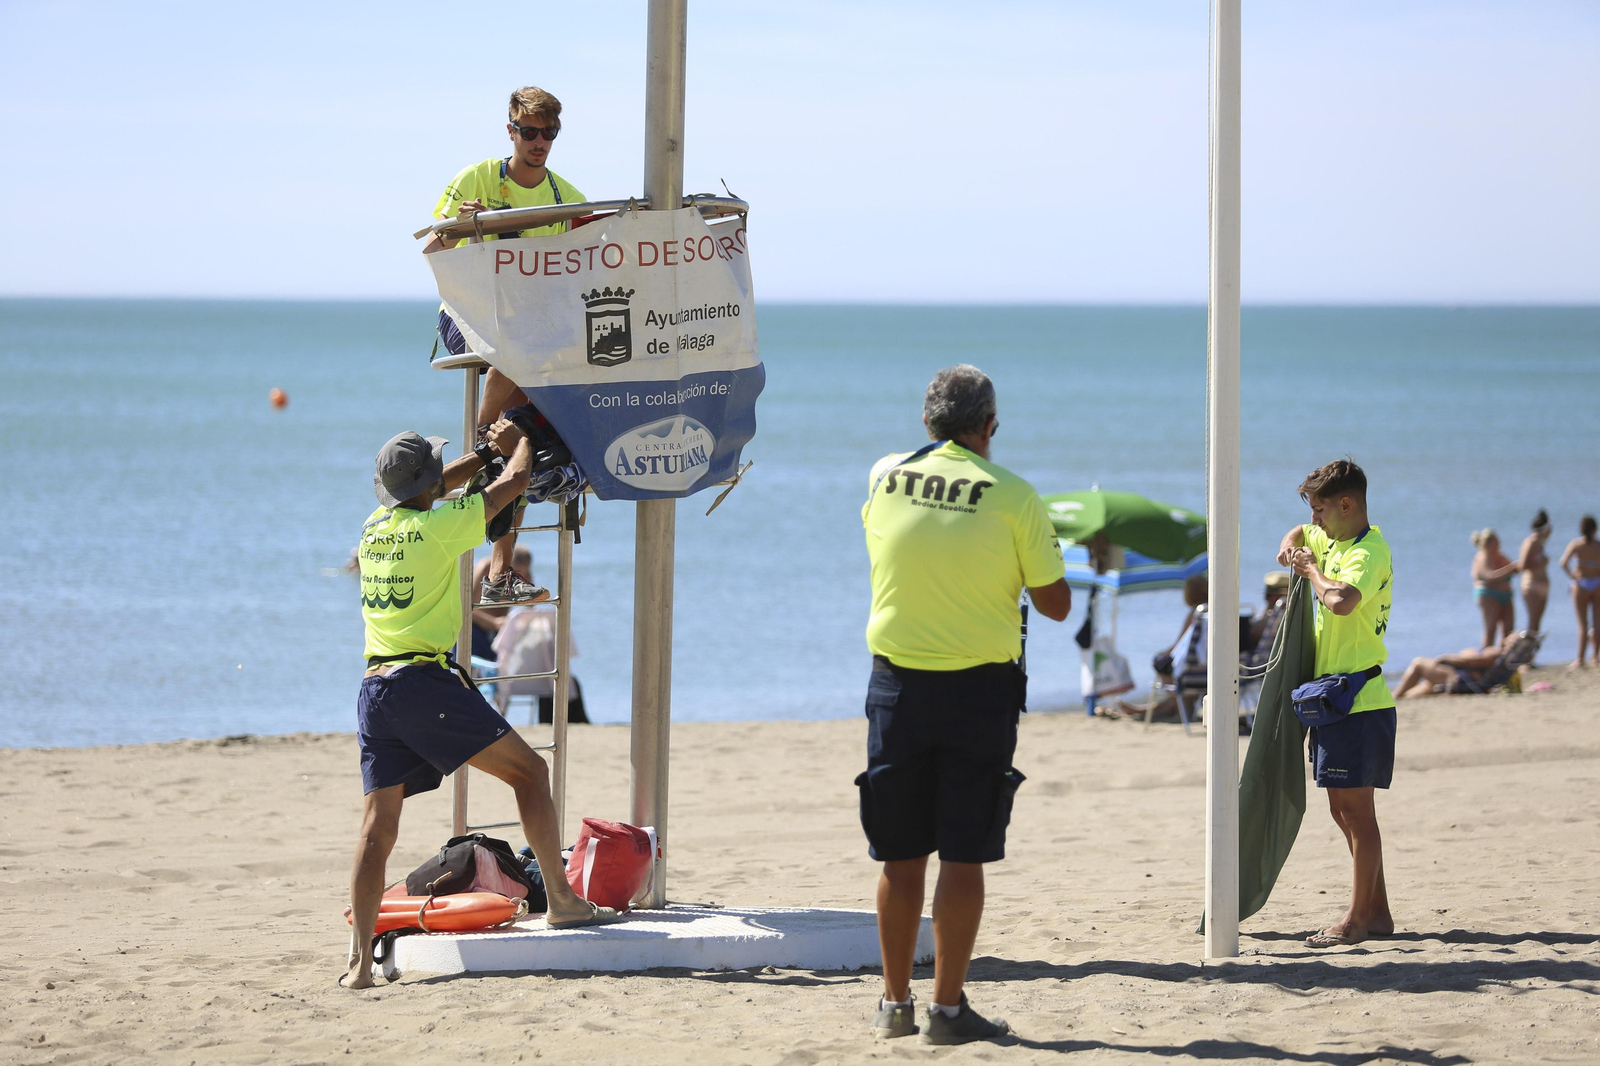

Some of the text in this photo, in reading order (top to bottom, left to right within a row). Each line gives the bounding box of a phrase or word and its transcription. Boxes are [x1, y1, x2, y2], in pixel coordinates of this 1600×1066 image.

[495, 243, 625, 276] PUESTO
[638, 241, 678, 266] DE
[646, 338, 670, 354] de
[589, 381, 731, 408] Con la colabción de:
[636, 442, 682, 452] CENTRA
[886, 469, 993, 505] STAFF
